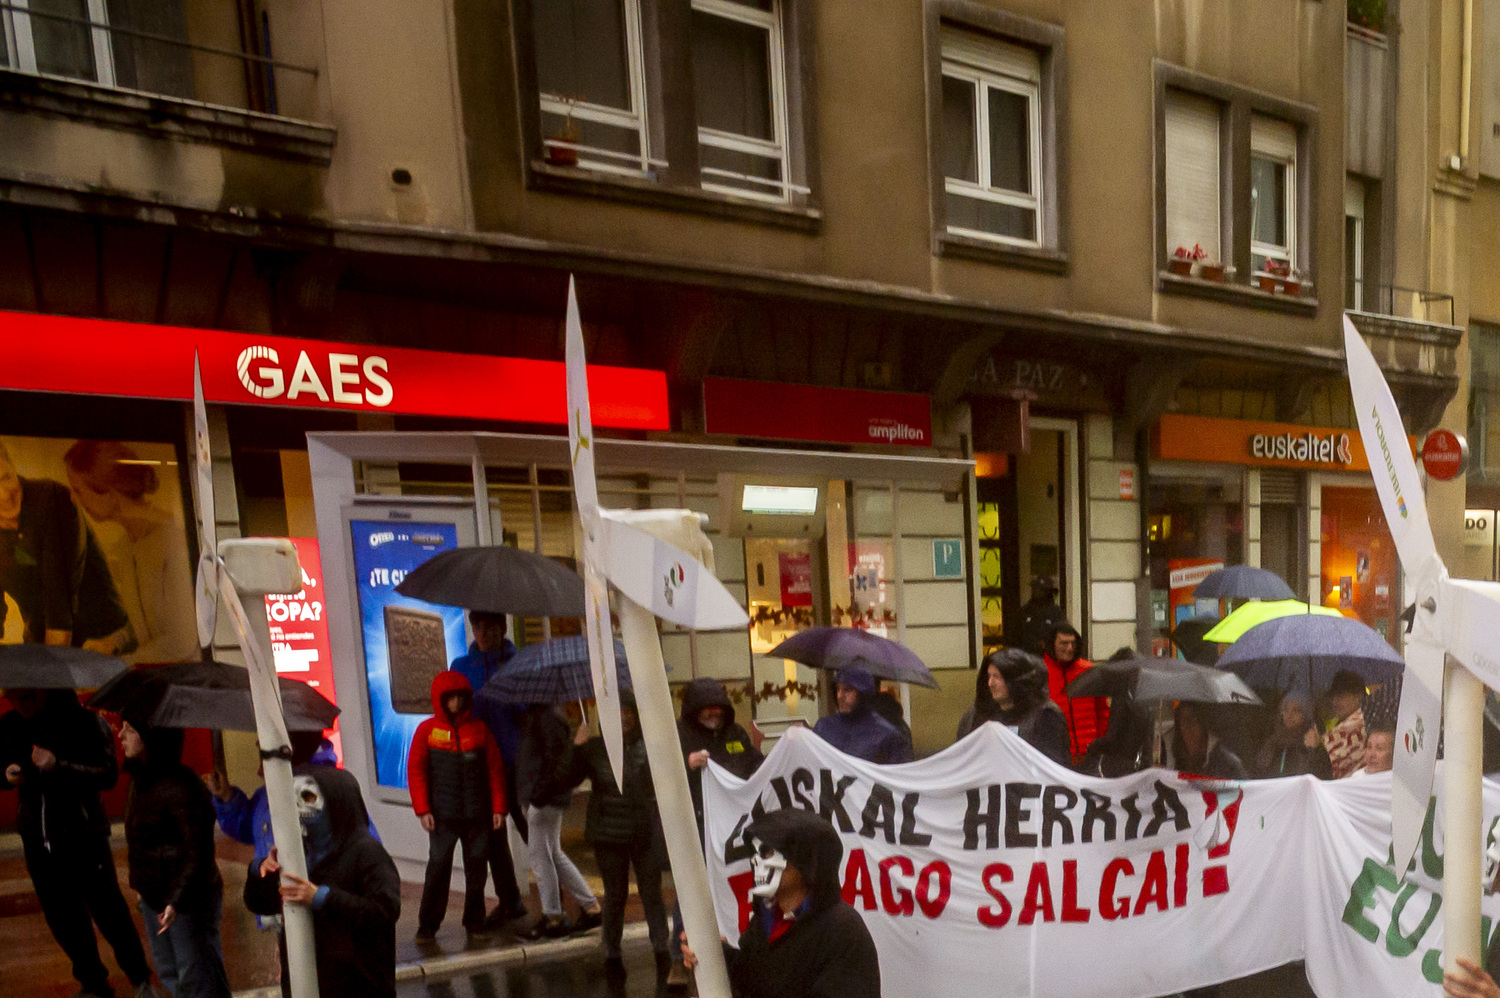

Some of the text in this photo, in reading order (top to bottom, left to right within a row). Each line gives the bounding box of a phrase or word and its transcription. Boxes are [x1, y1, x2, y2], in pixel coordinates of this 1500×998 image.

[236, 345, 394, 407] GAES
[868, 423, 924, 442] amplifon
[1252, 432, 1334, 462] euskaltel
[964, 779, 1191, 850] HERRIA
[841, 848, 952, 919] AGO
